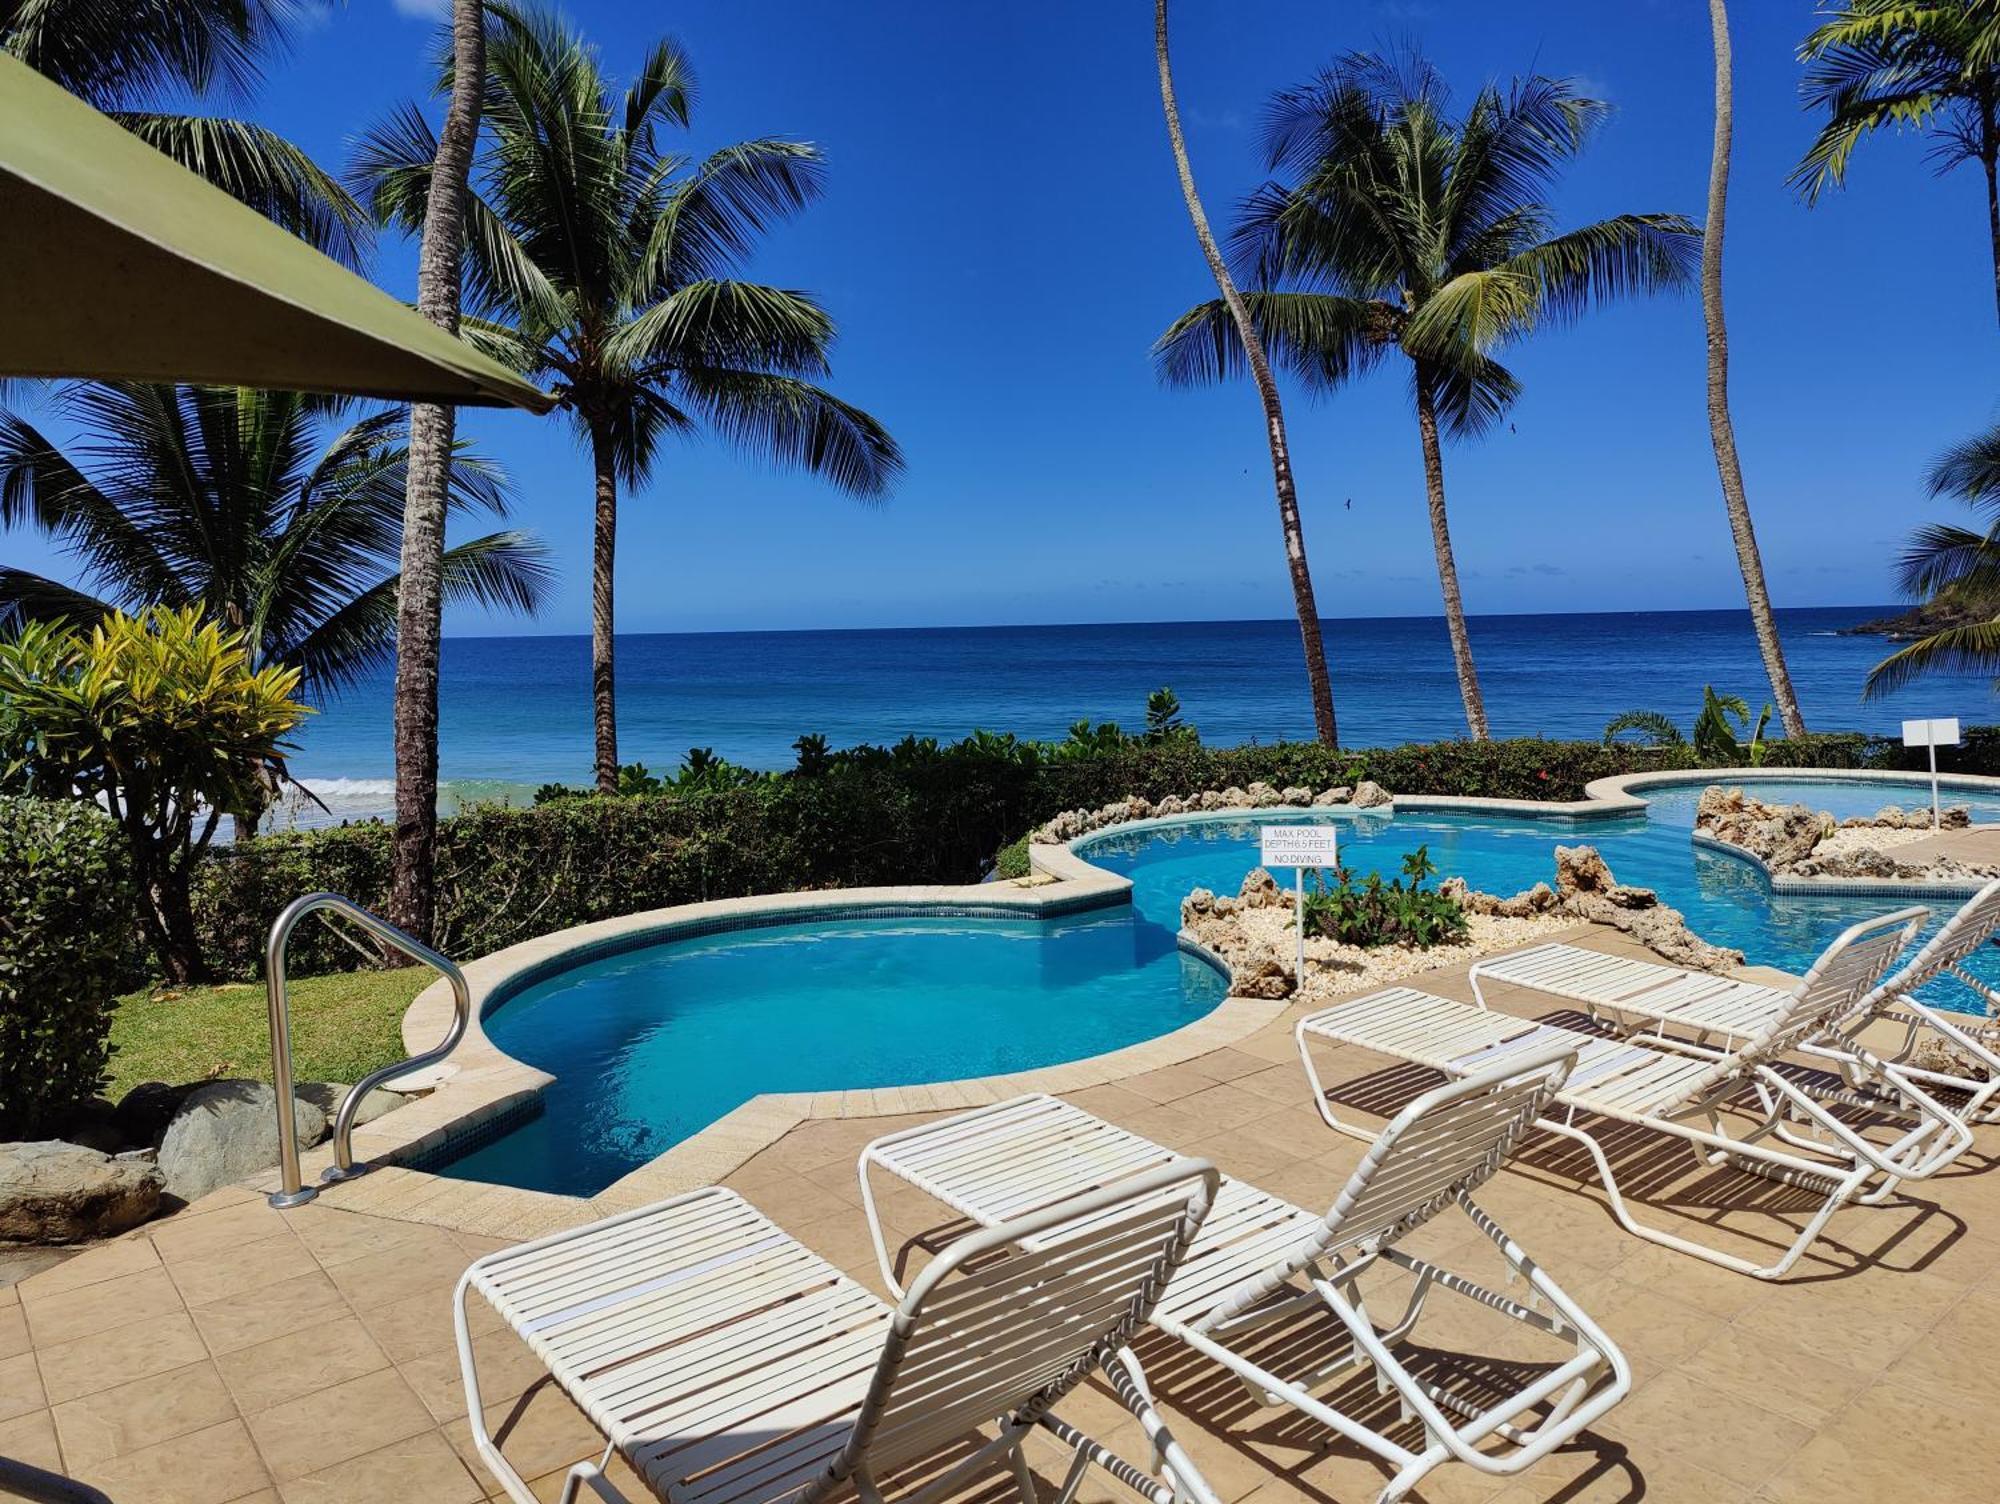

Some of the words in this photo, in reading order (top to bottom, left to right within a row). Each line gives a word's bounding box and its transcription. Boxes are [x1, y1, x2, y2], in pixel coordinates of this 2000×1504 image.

[1274, 829, 1294, 838] MAX
[1297, 829, 1322, 838] POOL
[1265, 839, 1294, 849] DEPTH
[1309, 839, 1331, 849] FEET
[1274, 854, 1289, 863] NO
[1290, 854, 1322, 863] DIVING
